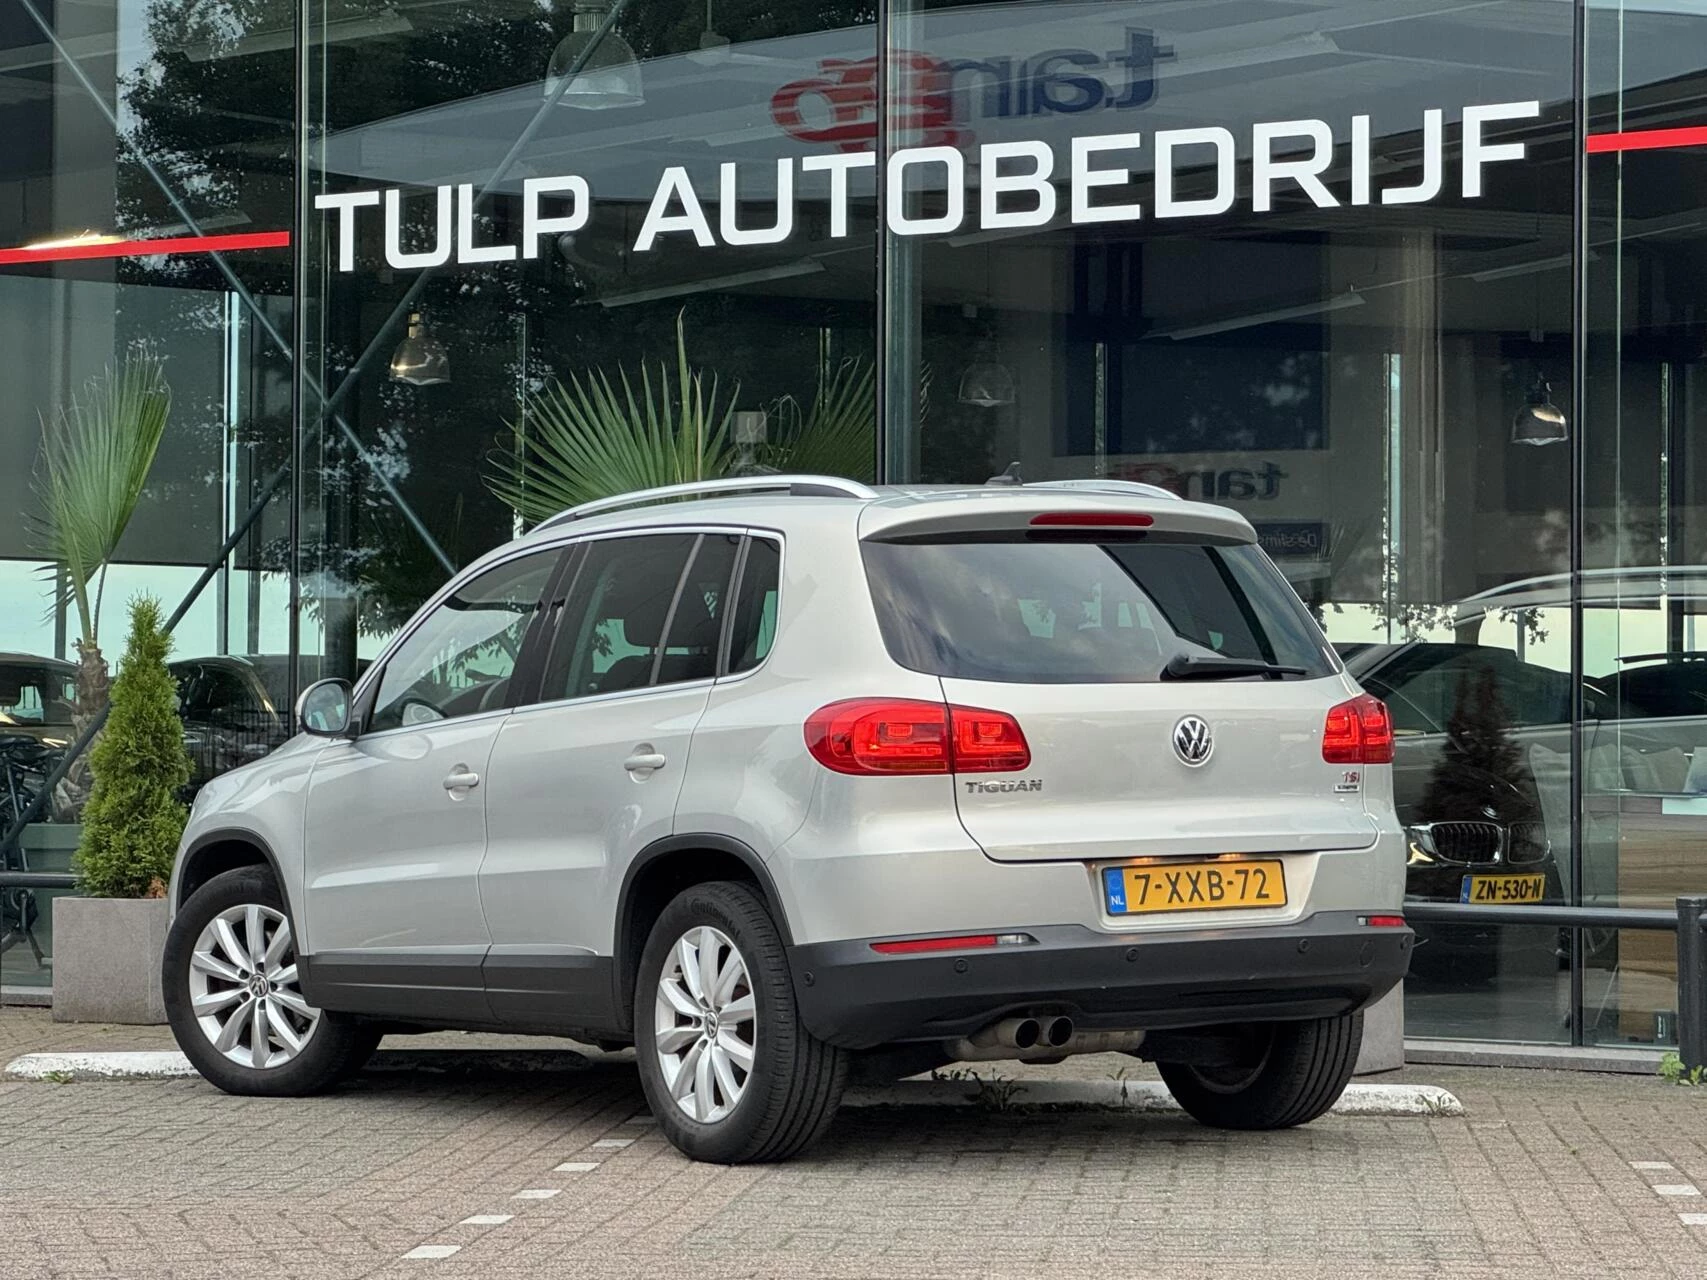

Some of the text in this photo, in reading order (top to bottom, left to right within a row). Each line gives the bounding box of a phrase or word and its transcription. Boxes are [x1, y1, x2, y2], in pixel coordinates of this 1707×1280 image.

[314, 101, 1540, 272] TULP AUTOBEDRIJF
[1111, 895, 1125, 906] NL
[1134, 868, 1269, 905] 7-XXB-72
[1475, 878, 1542, 900] ZN-530-N
